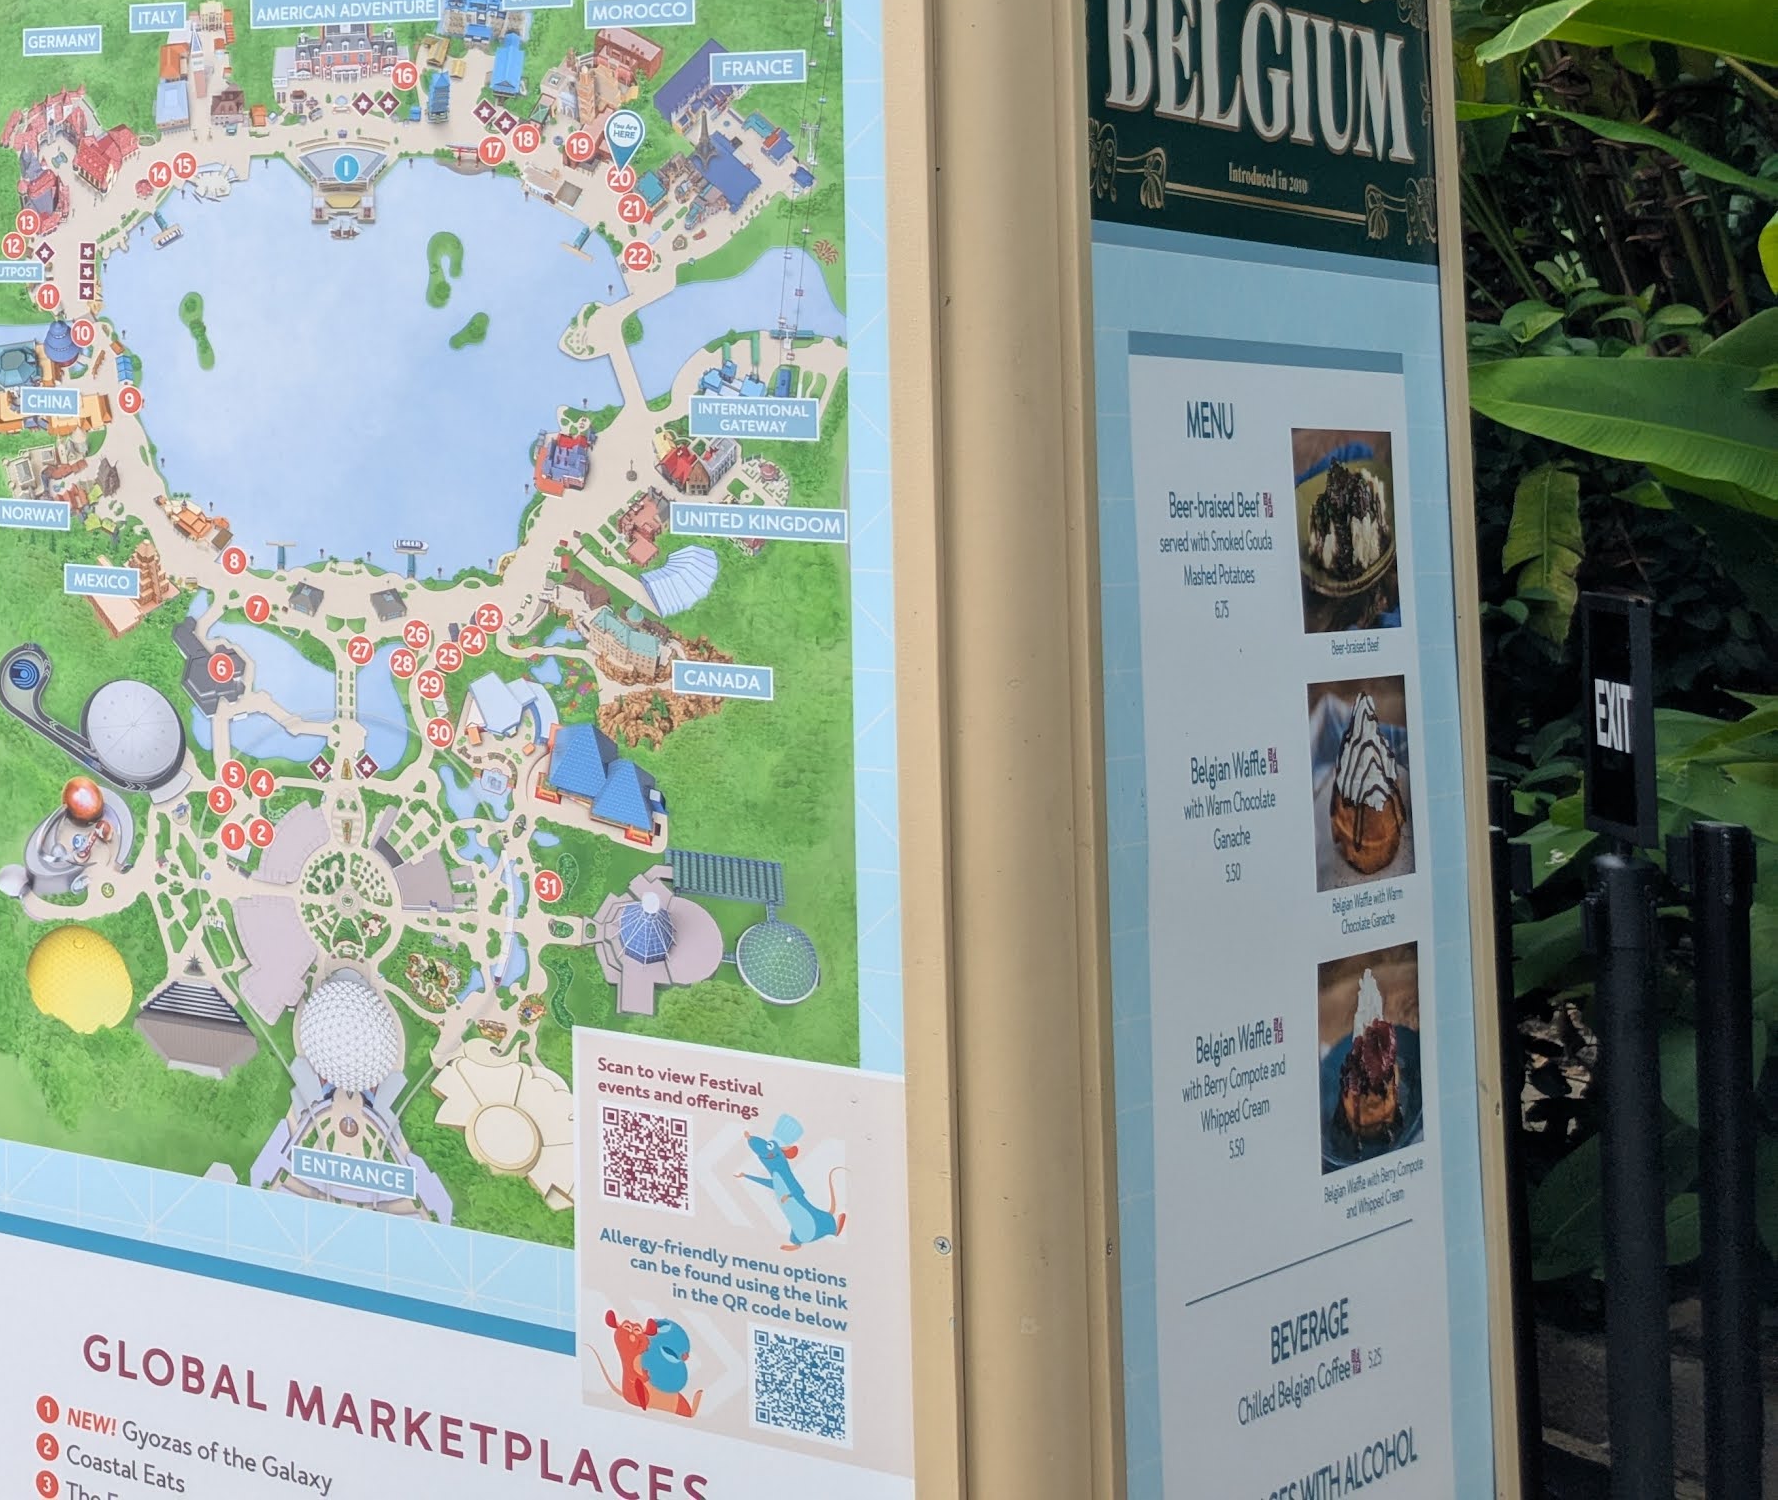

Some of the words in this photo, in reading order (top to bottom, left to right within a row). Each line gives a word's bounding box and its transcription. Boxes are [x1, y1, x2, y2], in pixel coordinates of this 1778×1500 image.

[137, 10, 176, 25] ITALY
[257, 4, 335, 21] AMERICAN
[340, 0, 435, 16] ADVENTURE
[592, 2, 686, 20] MOROCCO
[28, 33, 96, 50] GERMANY
[395, 68, 413, 83] 16
[722, 60, 793, 77] FRANCE
[518, 131, 534, 147] 18
[614, 130, 635, 139] HERE
[486, 142, 501, 158] 17
[571, 138, 588, 154] 19
[176, 158, 191, 173] 15
[152, 167, 167, 182] 14
[610, 171, 631, 186] 20
[1229, 162, 1276, 188] Introduced
[1278, 170, 1287, 191] in
[1289, 178, 1308, 194] 2010
[623, 201, 640, 217] 21
[20, 215, 34, 230] 13
[6, 238, 20, 253] 12
[628, 247, 648, 264] 22
[41, 290, 54, 304] 11
[74, 325, 90, 340] 10
[28, 394, 72, 409] CHINA
[125, 393, 134, 408] 9
[698, 403, 809, 418] INTERNATIONAL
[720, 418, 787, 433] GATEWAY
[1187, 401, 1234, 439] MENU
[1169, 492, 1235, 519] Beer-braised
[1237, 492, 1259, 517] Beef
[2, 506, 63, 523] NORWAY
[676, 511, 743, 529] UNITED
[748, 514, 841, 534] KINGDOM
[1160, 532, 1188, 552] served
[1191, 531, 1208, 551] with
[1211, 530, 1243, 551] Smoked
[1245, 530, 1272, 551] Gouda
[229, 553, 239, 568] 8
[74, 573, 129, 589] MEXICO
[1184, 564, 1217, 585] Mashed
[1219, 564, 1255, 584] Potatoes
[253, 602, 262, 616] 7
[480, 610, 498, 626] 23
[407, 626, 426, 643] 26
[463, 632, 483, 648] 24
[351, 642, 370, 658] 27
[439, 649, 457, 665] 25
[215, 660, 226, 676] 6
[394, 655, 413, 671] 28
[420, 676, 440, 692] 29
[684, 670, 760, 691] CANADA
[1595, 678, 1632, 753] EXIT
[429, 724, 450, 740] 30
[229, 767, 238, 782] 5
[1191, 756, 1230, 789] Belgian
[1233, 750, 1266, 778] Waffle
[257, 775, 267, 790] 4
[215, 792, 224, 807] 3
[1184, 798, 1203, 820] with
[1206, 795, 1232, 816] Warm
[1234, 790, 1276, 813] Chocolate
[229, 829, 236, 844] 1
[256, 825, 266, 840] 2
[1214, 826, 1251, 850] Ganache
[540, 878, 556, 895] 31
[1196, 1033, 1235, 1066] Belgian
[1238, 1021, 1272, 1053] Waffle
[598, 1057, 633, 1076] Scan
[637, 1064, 654, 1079] to
[658, 1068, 695, 1085] view
[700, 1074, 763, 1096] Festival
[1182, 1079, 1202, 1102] with
[1204, 1072, 1227, 1099] Berry
[1230, 1062, 1269, 1090] Compote
[1270, 1054, 1285, 1077] and
[598, 1081, 650, 1099] events
[654, 1090, 683, 1105] and
[687, 1094, 759, 1119] offerings
[1201, 1102, 1240, 1134] Whipped
[1243, 1098, 1269, 1119] Cream
[301, 1154, 406, 1189] ENTRANCE
[600, 1228, 728, 1268] Allergy-friendly
[732, 1256, 779, 1275] menu
[783, 1266, 847, 1288] options
[631, 1257, 657, 1272] can
[662, 1260, 680, 1277] be
[685, 1265, 731, 1287] found
[736, 1277, 780, 1300] using
[784, 1283, 811, 1302] the
[816, 1290, 848, 1310] link
[672, 1284, 687, 1298] in
[691, 1289, 718, 1305] the
[722, 1294, 747, 1312] QR
[751, 1301, 791, 1320] code
[795, 1309, 848, 1331] below
[1271, 1298, 1349, 1364] BEVERAGE
[1238, 1384, 1275, 1426] Chilled
[1278, 1376, 1315, 1408] Belgian
[1318, 1358, 1350, 1390] Coffee
[83, 1333, 267, 1411] GLOBAL
[285, 1380, 709, 1500] MARKETPLACES
[45, 1402, 51, 1417] 1
[67, 1408, 117, 1436] NEW!
[123, 1421, 192, 1456] Gyozas
[197, 1441, 219, 1462] of
[223, 1447, 256, 1472] the
[262, 1456, 332, 1495] Galaxy
[44, 1440, 51, 1454] 2
[66, 1445, 137, 1480] Coastal
[145, 1464, 185, 1492] Eats
[1300, 1460, 1340, 1500] WITH
[1345, 1426, 1417, 1495] ALCOHOL
[43, 1477, 51, 1491] 3
[66, 1480, 101, 1500] The
